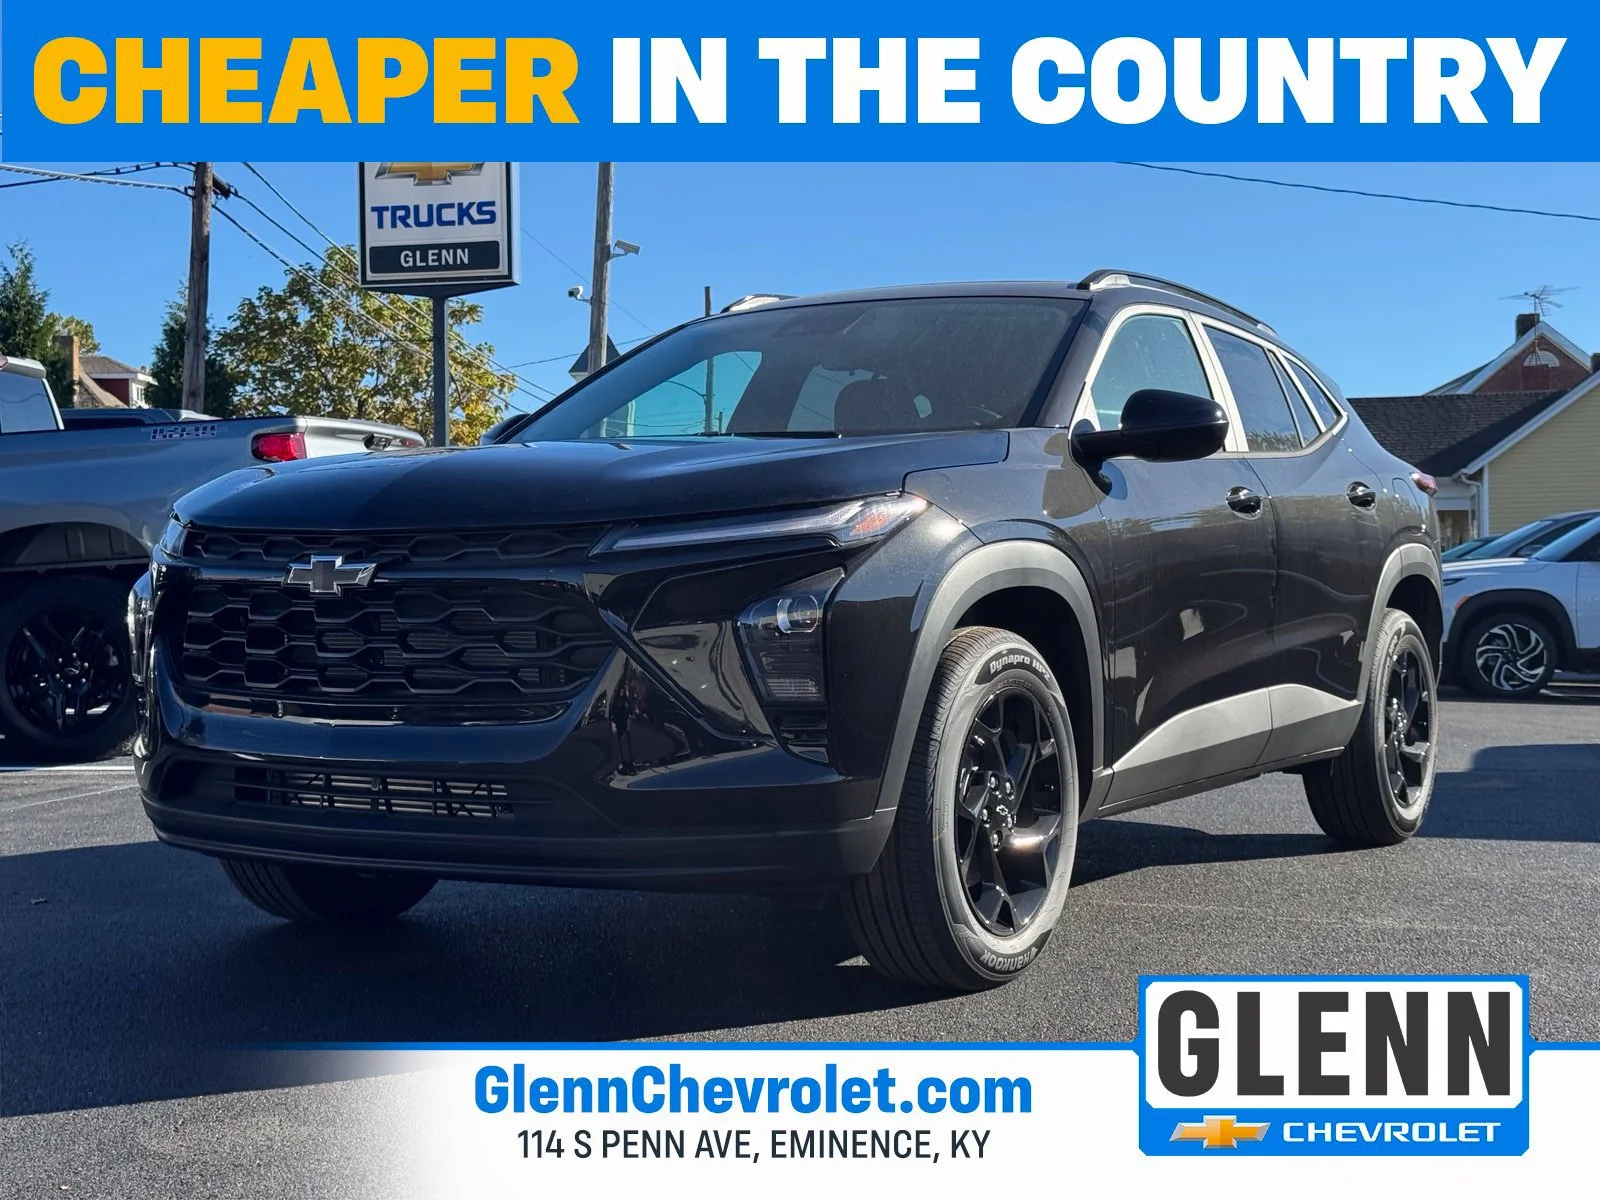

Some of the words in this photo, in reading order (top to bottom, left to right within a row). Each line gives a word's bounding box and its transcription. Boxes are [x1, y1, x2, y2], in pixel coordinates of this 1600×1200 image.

[370, 201, 497, 229] TRUCKS
[400, 248, 470, 267] GLENN
[990, 654, 1030, 674] Dynapro
